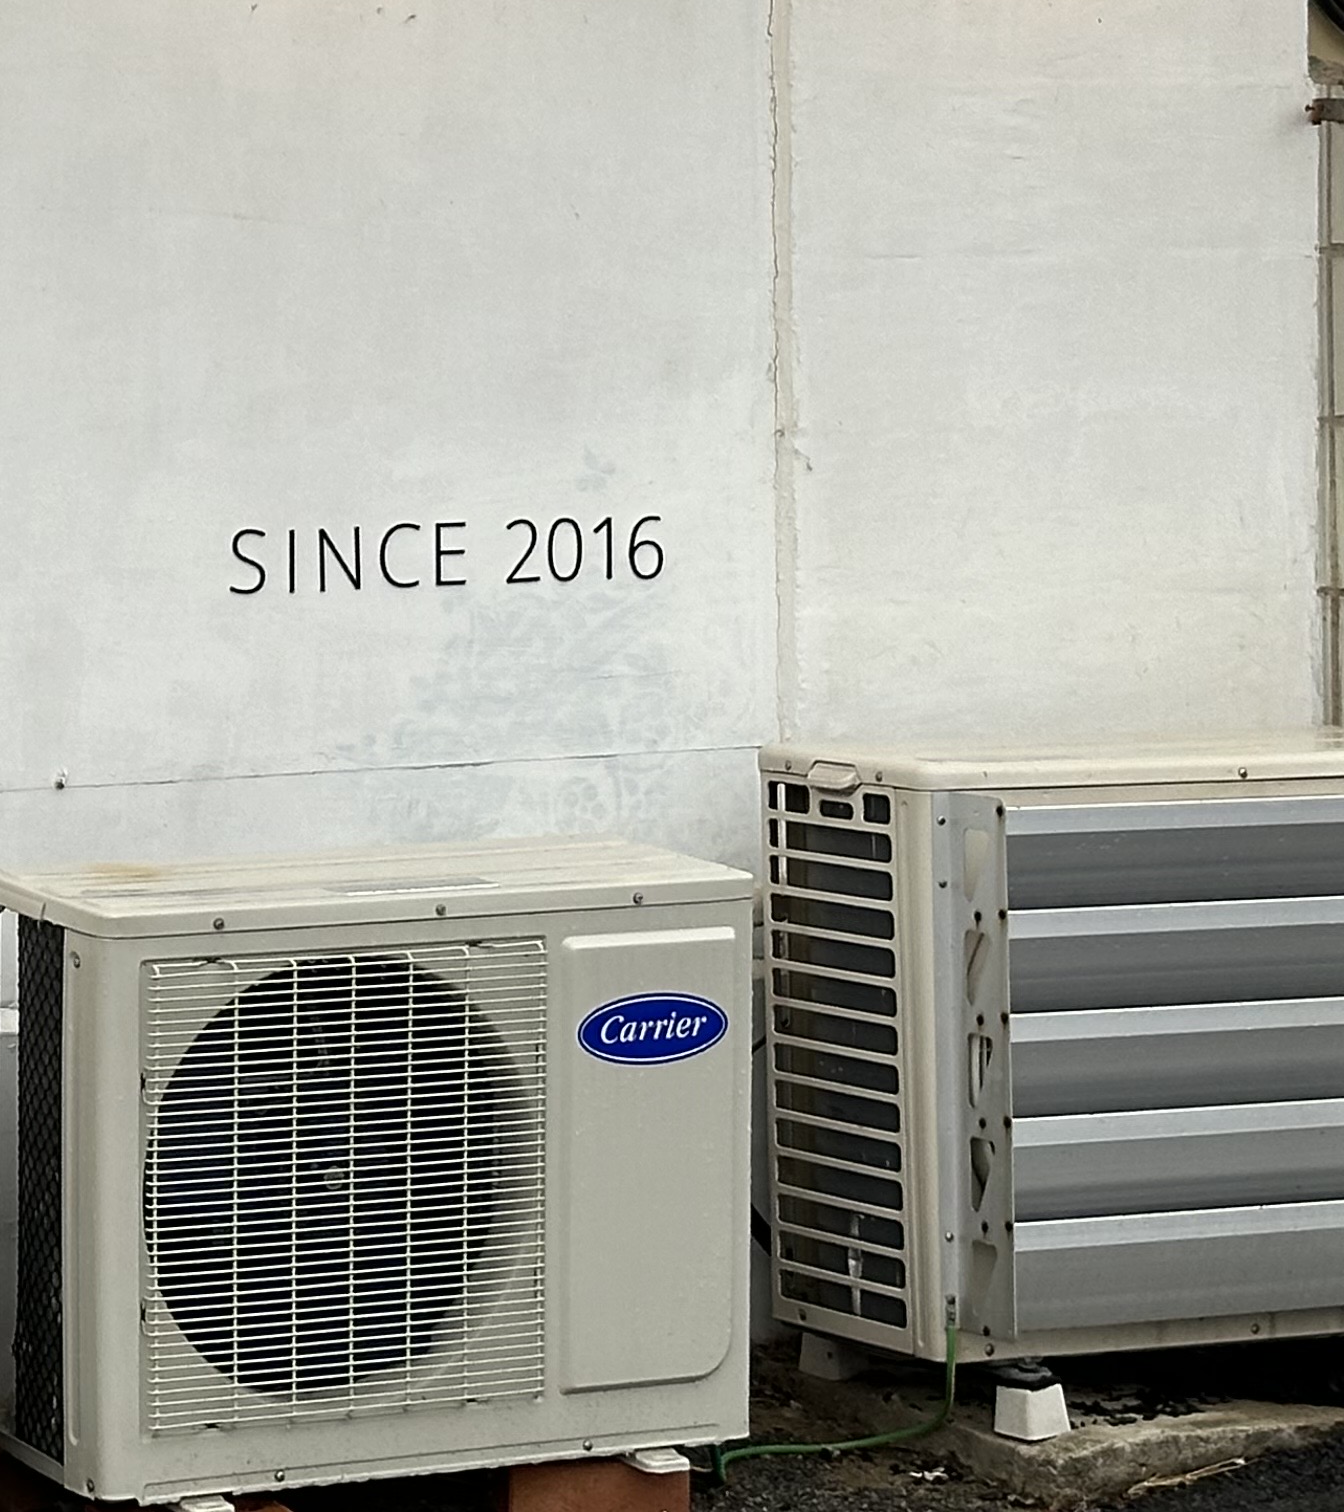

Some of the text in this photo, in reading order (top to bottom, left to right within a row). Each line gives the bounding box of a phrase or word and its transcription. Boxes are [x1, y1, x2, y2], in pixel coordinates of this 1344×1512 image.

[230, 515, 664, 594] SINCE 2016
[600, 1011, 708, 1045] Carrier
